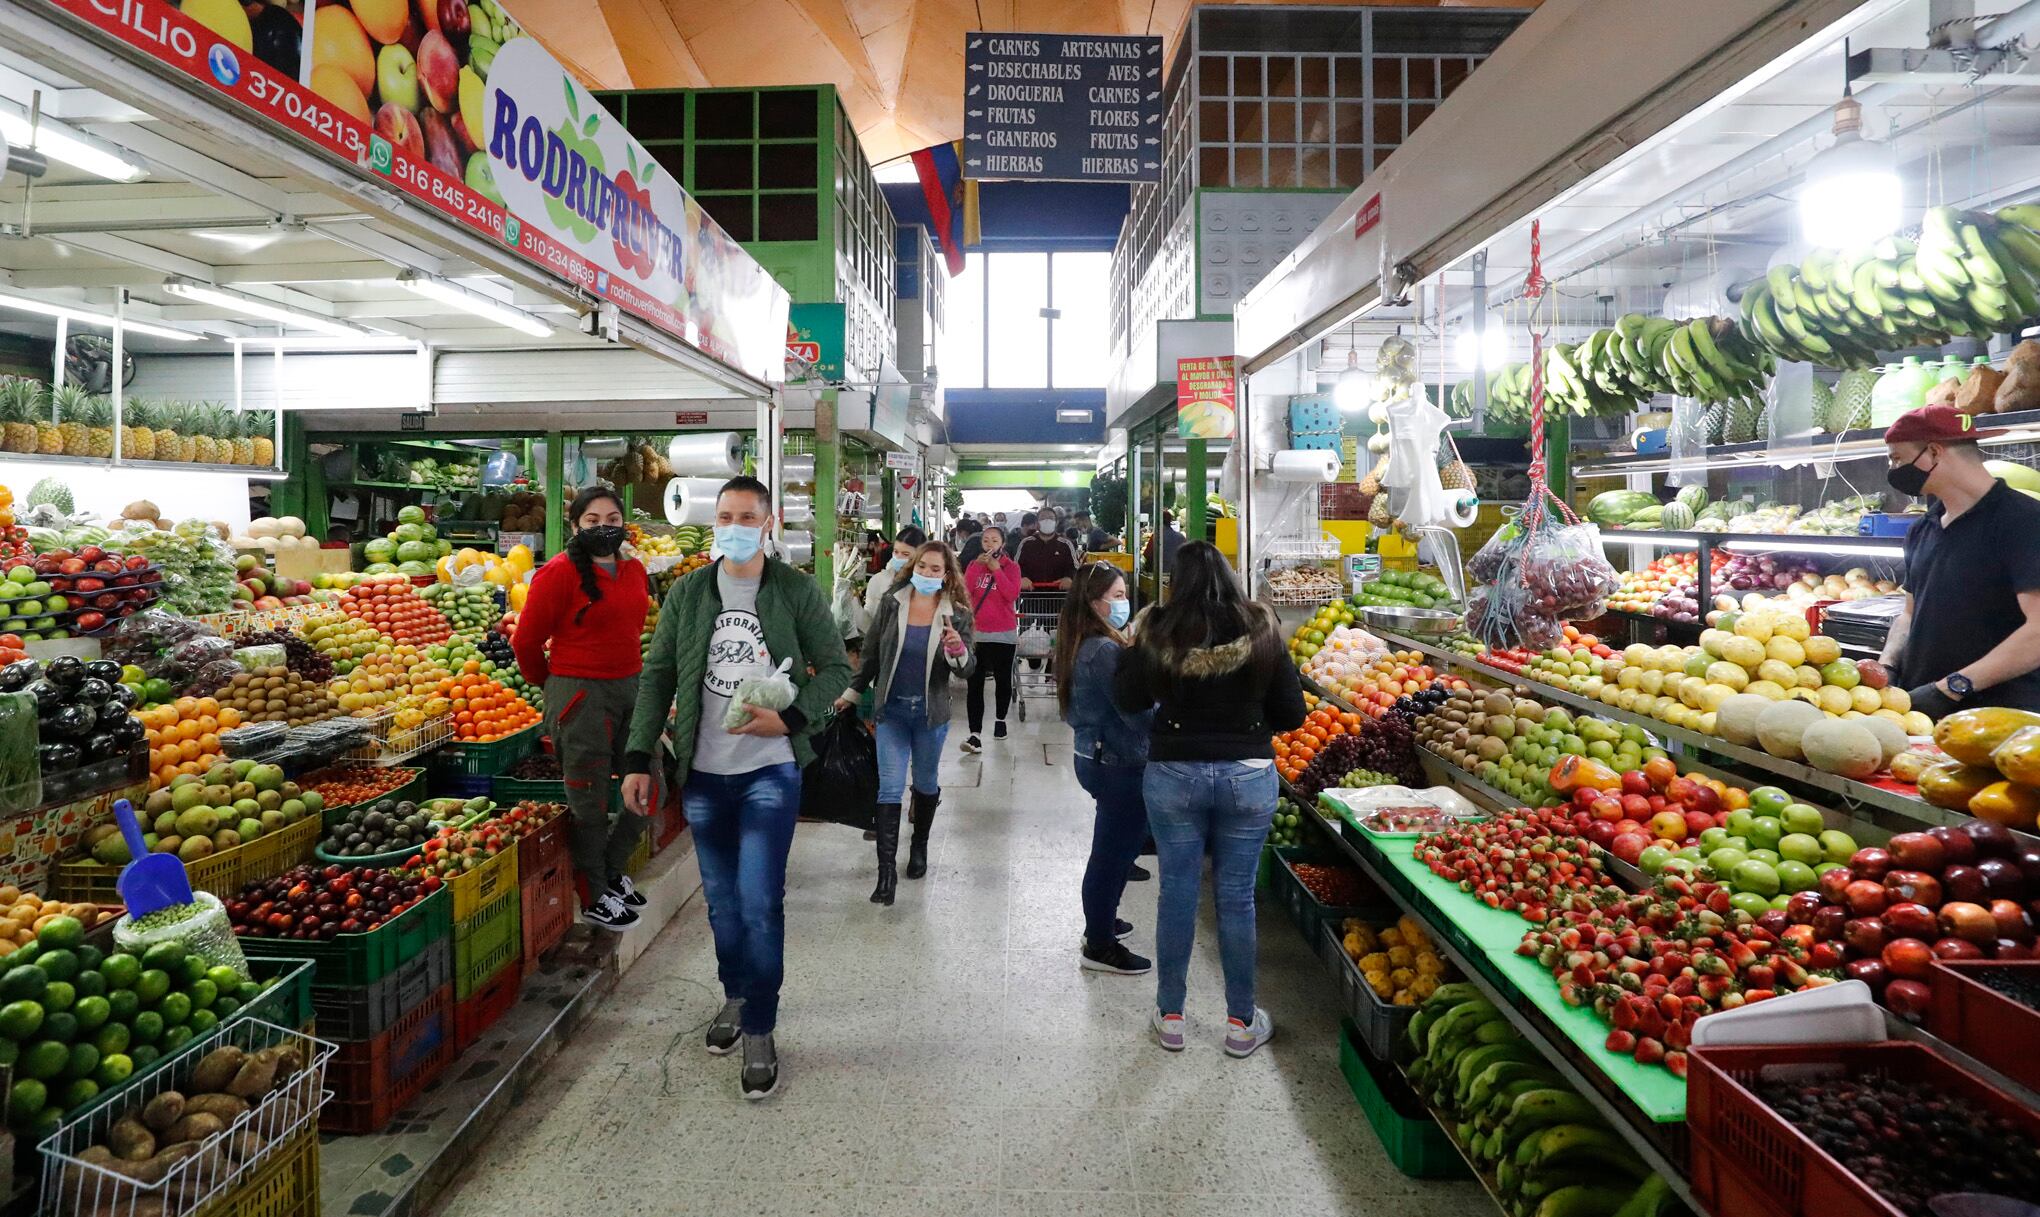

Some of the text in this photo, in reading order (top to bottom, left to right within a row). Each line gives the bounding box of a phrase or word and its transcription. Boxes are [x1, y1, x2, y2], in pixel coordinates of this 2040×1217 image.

[989, 39, 1040, 56] CARNES
[1060, 41, 1141, 59] ARTESANIAS
[988, 62, 1082, 80] DESECHABLES
[1107, 65, 1140, 81] AVES
[988, 84, 1065, 103] DROGUERIA
[1088, 87, 1140, 104] CARNES
[987, 107, 1036, 125] FRUTAS
[1089, 109, 1140, 127] FLORES
[986, 130, 1057, 149] GRANEROS
[1090, 133, 1139, 150] FRUTAS
[247, 70, 361, 152] 3704213
[394, 157, 429, 191] 316
[431, 178, 465, 210] 845
[466, 198, 501, 232] 2416
[523, 232, 547, 256] 310
[547, 245, 568, 269] 234
[986, 155, 1043, 173] HIERBAS
[1081, 157, 1139, 175] HIERBAS
[489, 87, 683, 284] RODRIFRUVER
[714, 617, 765, 645] LIFORNIA
[706, 670, 744, 690] REPUB
